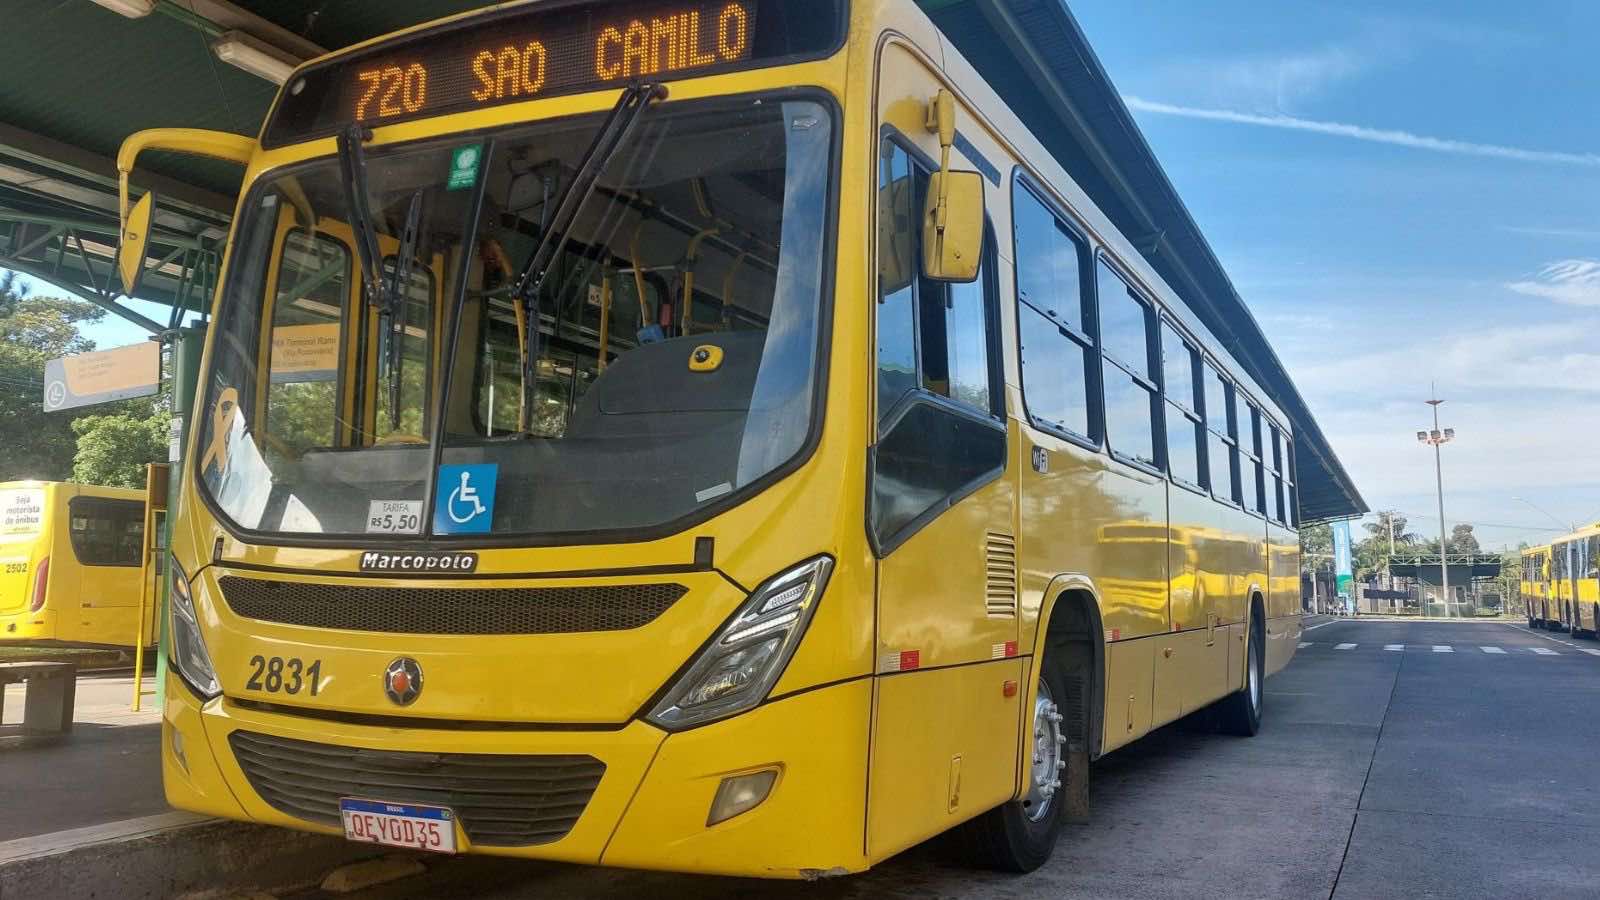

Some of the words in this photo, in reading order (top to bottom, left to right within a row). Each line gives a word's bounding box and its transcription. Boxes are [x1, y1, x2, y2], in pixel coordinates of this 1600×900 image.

[355, 62, 427, 121] 720
[471, 40, 547, 102] SAO
[595, 2, 748, 81] CAMILO
[6, 506, 41, 515] motorista
[383, 502, 410, 513] TARIFA
[5, 516, 14, 526] de
[361, 552, 474, 571] Marcopolo
[6, 563, 27, 574] 2502
[246, 654, 322, 697] 2831
